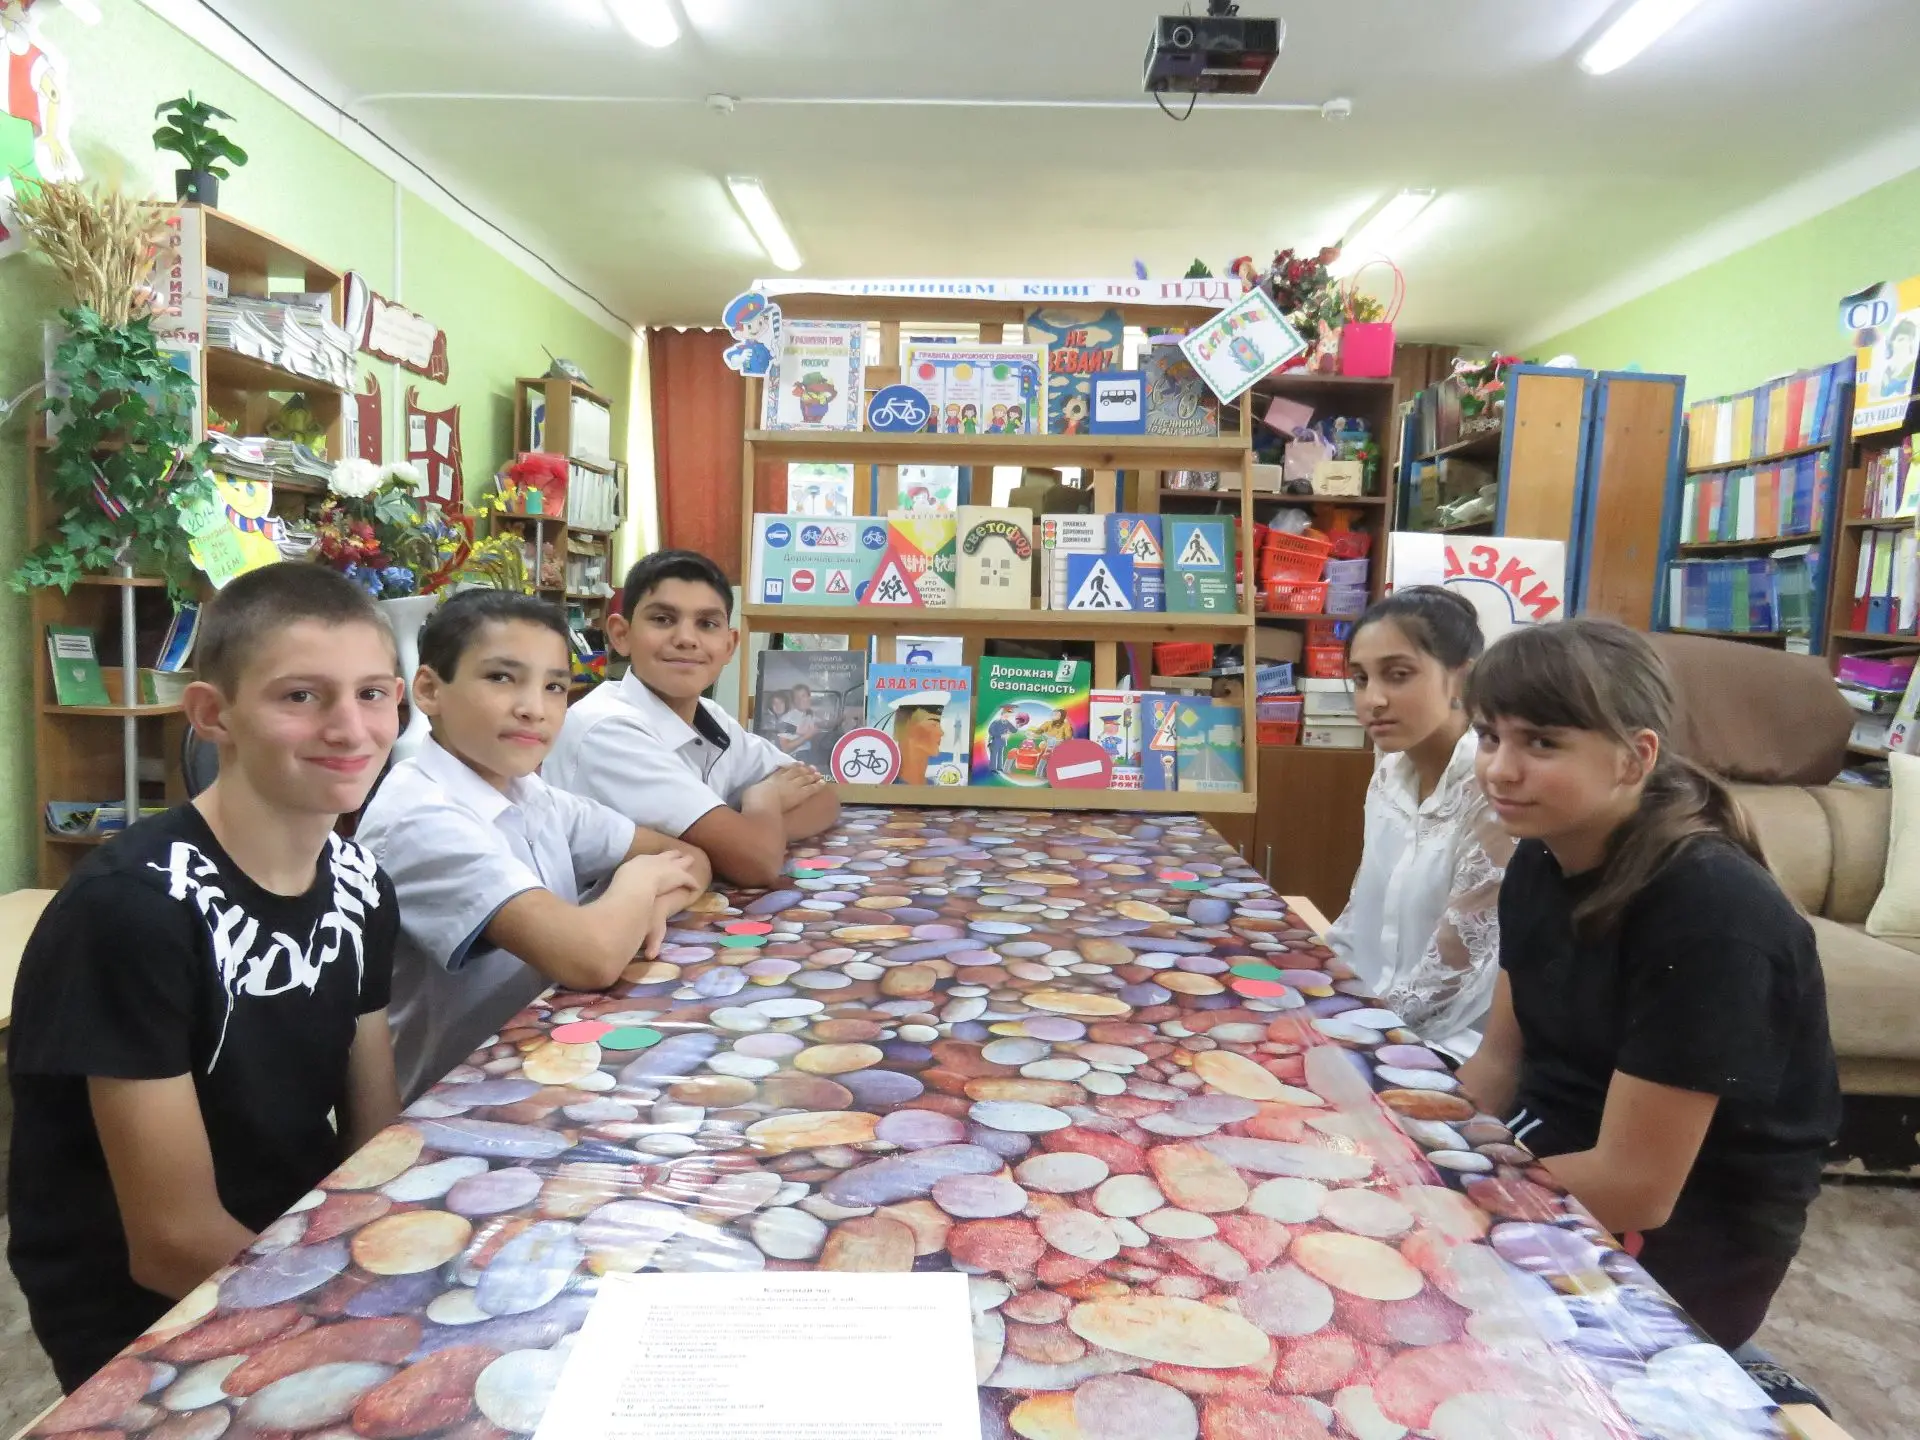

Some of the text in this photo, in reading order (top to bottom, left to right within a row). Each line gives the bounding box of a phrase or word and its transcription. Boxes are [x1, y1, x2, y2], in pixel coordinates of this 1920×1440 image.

[1106, 286, 1141, 297] по
[1160, 282, 1233, 302] ПДД
[1847, 300, 1889, 329] CD
[1064, 330, 1088, 348] НЕ
[1443, 544, 1562, 622] АЗКИ
[1143, 596, 1155, 608] 2
[1203, 597, 1215, 609] 3
[990, 664, 1054, 678] Дорожная
[1062, 664, 1071, 676] 3
[875, 677, 968, 691] ДЯДЯ СТЕПА
[989, 677, 1076, 694] безопасность
